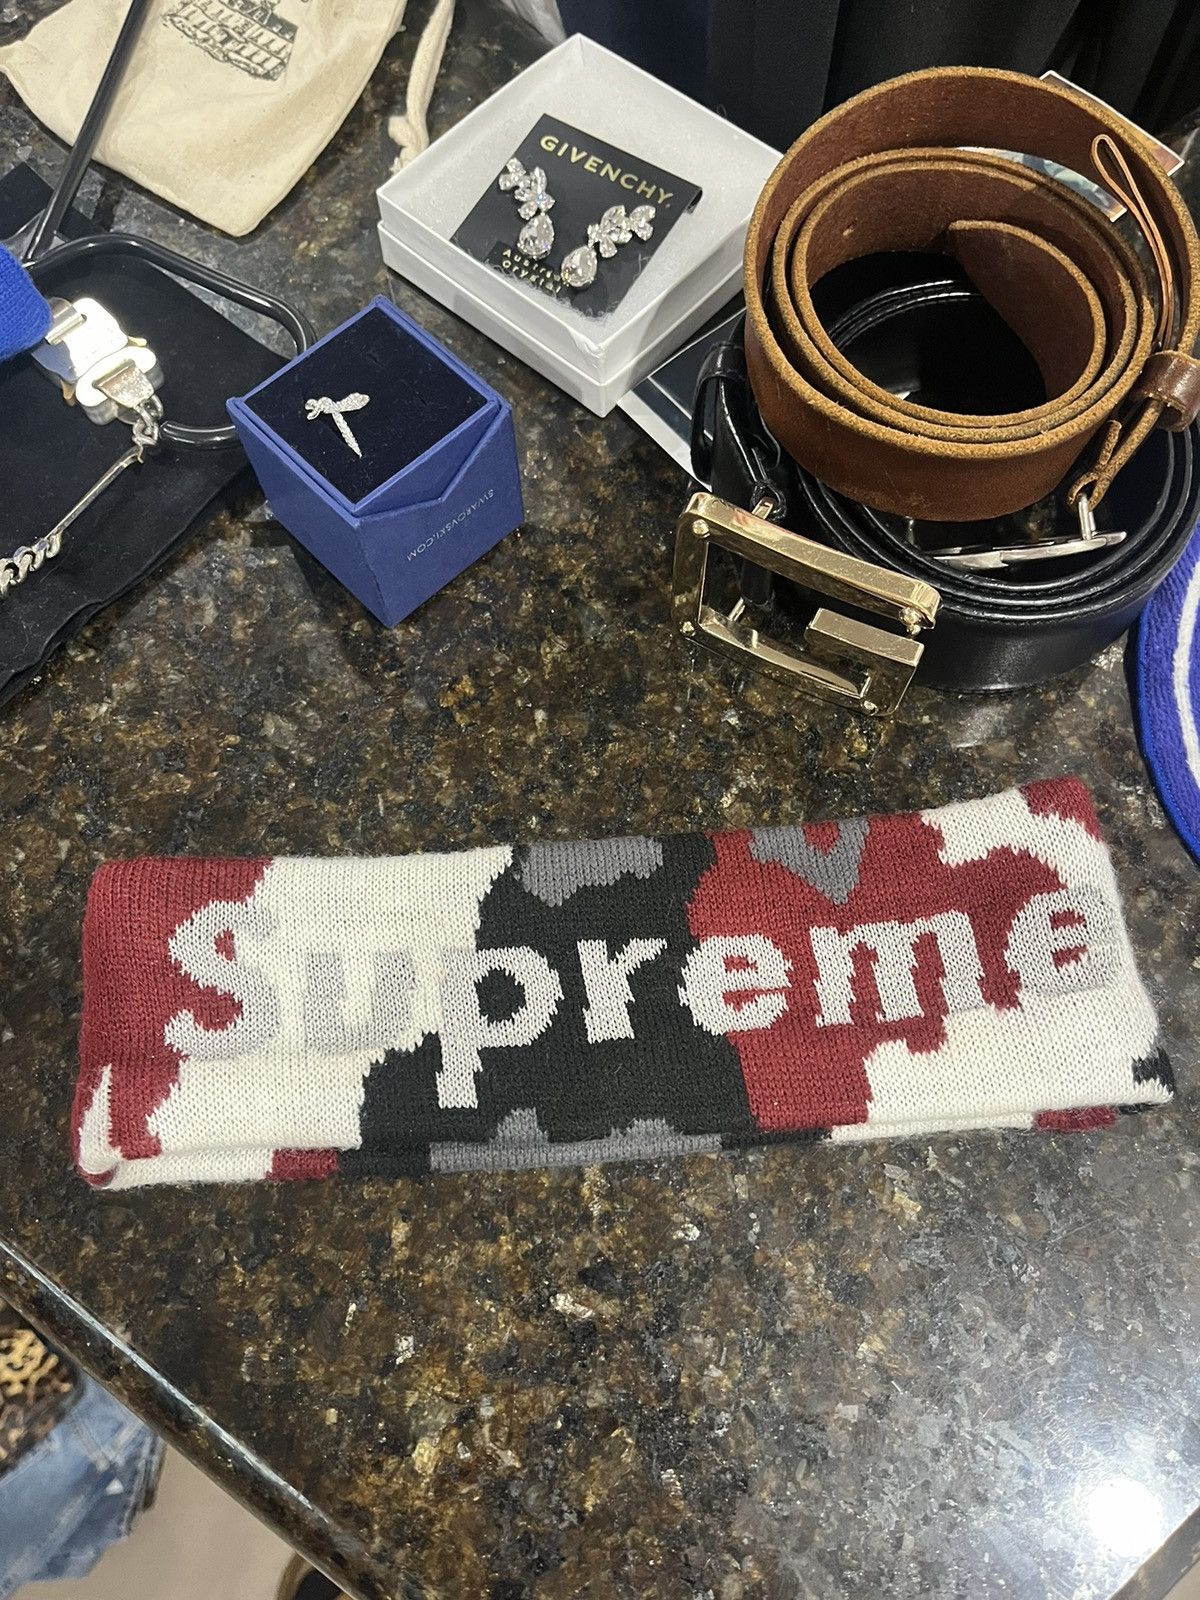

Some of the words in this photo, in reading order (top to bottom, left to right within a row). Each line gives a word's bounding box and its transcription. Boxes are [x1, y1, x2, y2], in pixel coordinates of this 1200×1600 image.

[539, 135, 674, 204] GIVENCHY
[406, 488, 495, 561] SWAROVSKI.COM
[164, 886, 1124, 1109] Supreme
